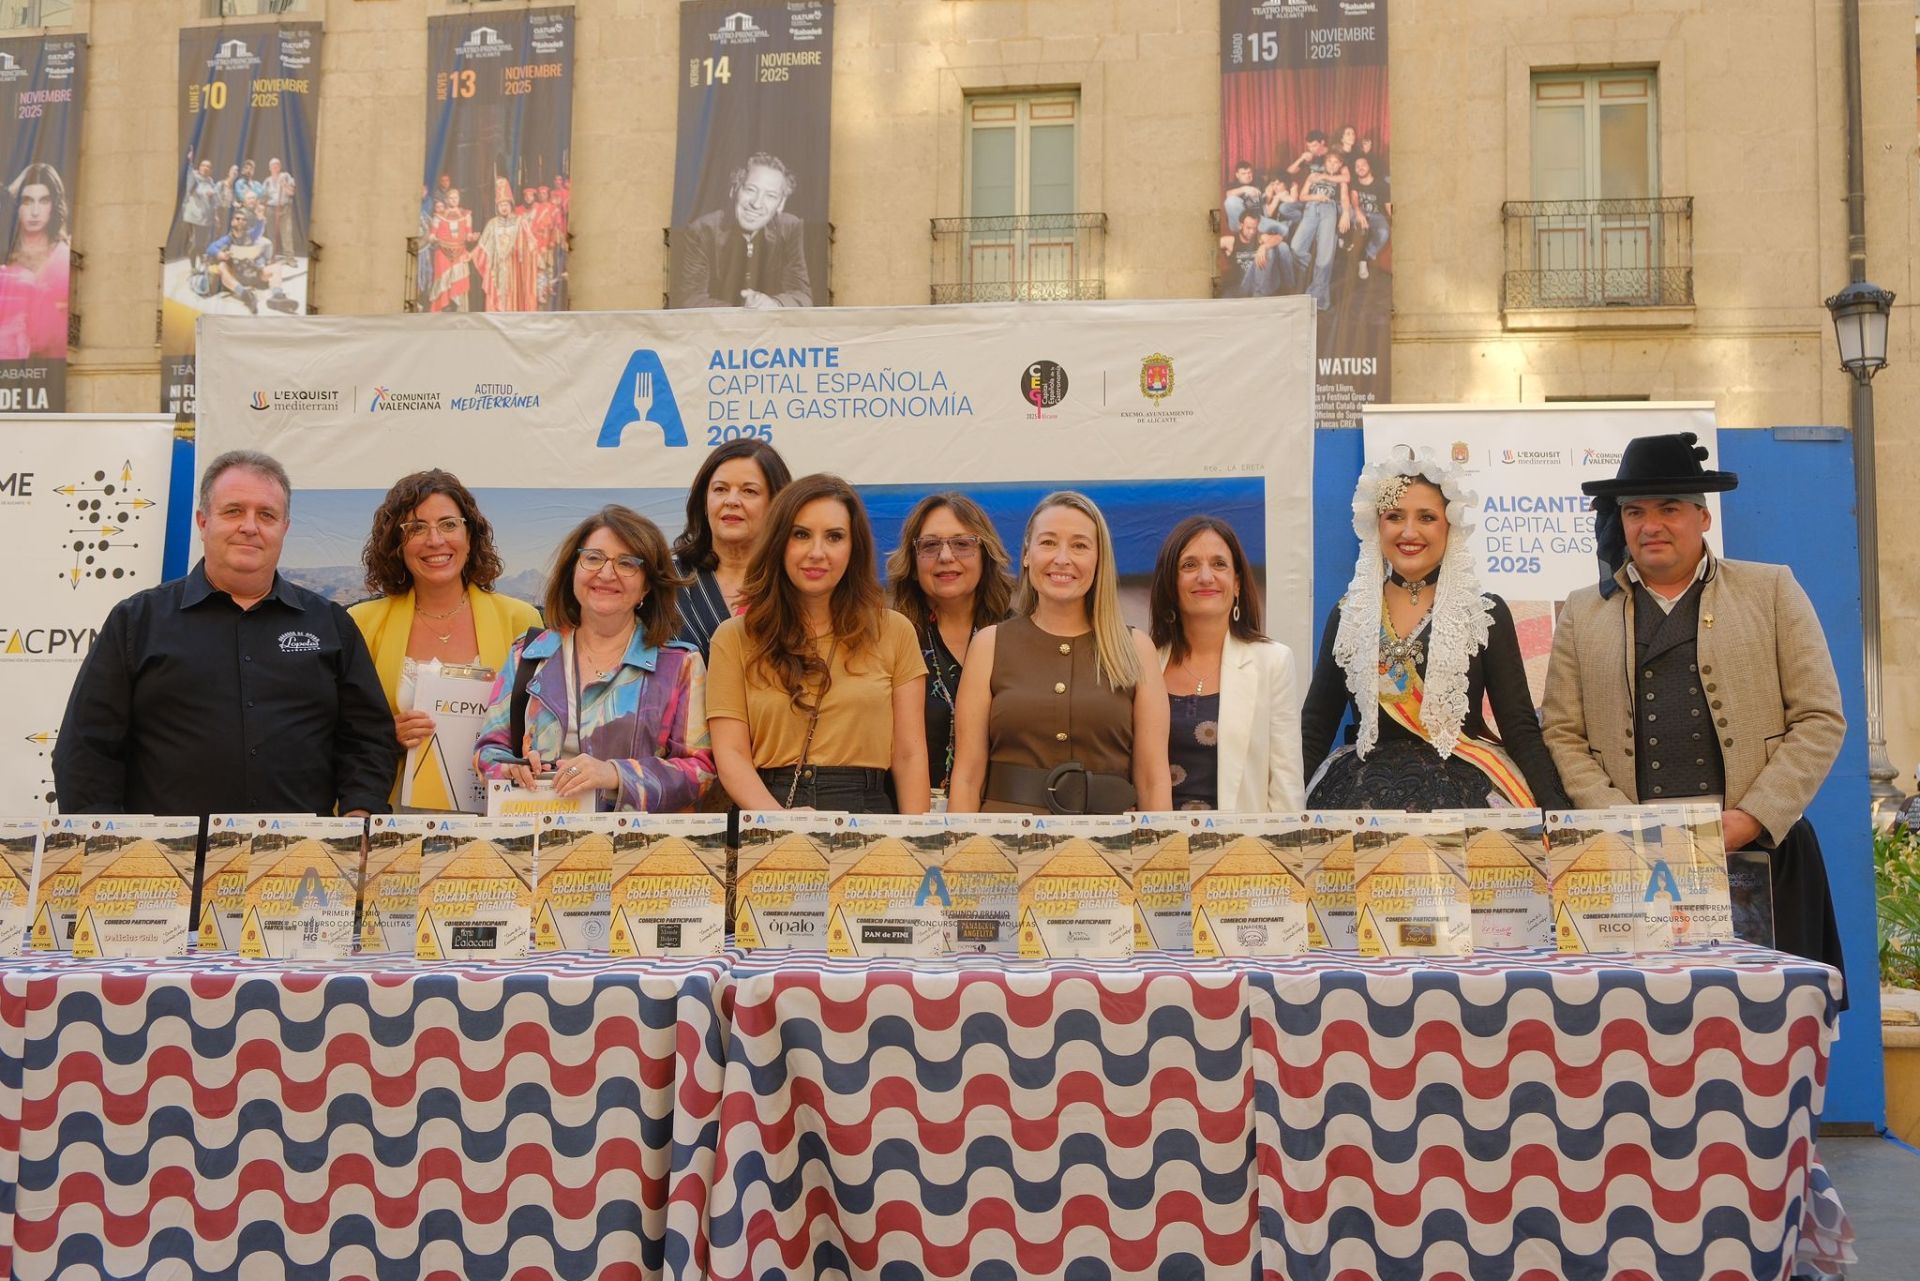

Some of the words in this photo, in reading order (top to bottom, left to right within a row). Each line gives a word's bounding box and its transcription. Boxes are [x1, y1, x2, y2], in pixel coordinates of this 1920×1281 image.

[1252, 6, 1281, 15] TEATRO
[1281, 5, 1318, 14] PRINCIPAL
[708, 31, 735, 40] TEATRO
[735, 30, 770, 38] PRINCIPAL
[1310, 26, 1376, 43] NOVIEMBRE
[1247, 31, 1279, 62] 15
[1310, 43, 1342, 60] 2025
[761, 51, 822, 67] NOVIEMBRE
[505, 64, 563, 80] NOVIEMBRE
[703, 55, 731, 86] 14
[760, 68, 789, 83] 2025
[252, 79, 310, 94] NOVIEMBRE
[450, 70, 476, 98] 13
[505, 80, 532, 95] 2025
[20, 89, 72, 104] NOVIEMBRE
[189, 84, 200, 113] LUNES
[202, 81, 227, 110] 10
[251, 93, 279, 108] 2025
[19, 105, 42, 119] 2025
[708, 347, 839, 370] ALICANTE
[1318, 357, 1377, 376] WATUSI
[708, 374, 808, 395] CAPITAL
[817, 368, 948, 393] ESPAÑOLA
[274, 391, 338, 401] L'EXQUISIT
[391, 393, 441, 401] COMUNITAT
[475, 384, 514, 395] ACTITUD
[27, 387, 49, 409] LA
[451, 393, 540, 411] MEDITERRÁNEA
[274, 400, 338, 412] mediterrani
[380, 401, 442, 411] VALENCIANA
[708, 401, 740, 421] DE
[750, 400, 778, 420] LA
[787, 392, 973, 419] GASTRONOMÍA
[707, 424, 773, 447] 2025
[1484, 496, 1591, 513] ALICANTE
[1484, 516, 1567, 533] CAPITAL
[1487, 537, 1512, 553] DE
[1520, 537, 1544, 553] LA
[1487, 556, 1541, 573] 2025
[97, 878, 181, 893] CONCURSO
[434, 879, 518, 893] CONCURSO
[627, 877, 711, 891] CONCURSO
[1034, 878, 1119, 892] CONCURSO
[1207, 875, 1291, 891] CONCURSO
[1371, 876, 1456, 890] CONCURSO
[1491, 880, 1534, 889] MOLLITAS
[1568, 886, 1593, 895] COCA
[95, 891, 120, 901] COCA
[120, 891, 135, 900] DE
[135, 890, 178, 900] MOLLITAS
[434, 892, 459, 902] COCA
[460, 892, 474, 901] DE
[474, 890, 518, 900] MOLLITAS
[653, 889, 667, 898] DE
[667, 887, 711, 898] MOLLITAS
[845, 891, 870, 899] COCA
[1035, 891, 1060, 900] COCA
[1061, 890, 1075, 899] DE
[1076, 889, 1119, 899] MOLLITAS
[1207, 890, 1232, 899] COCA
[1233, 889, 1247, 898] DE
[1247, 887, 1290, 898] MOLLITAS
[1371, 889, 1397, 898] COCA
[1398, 888, 1412, 897] DE
[1412, 887, 1456, 897] MOLLITAS
[1496, 889, 1534, 898] GIGANTE
[553, 894, 594, 909] 2025
[628, 900, 669, 916] 2025
[671, 898, 711, 908] GIGANTE
[752, 893, 793, 908] 2025
[846, 900, 888, 916] 2025
[1036, 901, 1078, 917] 2025
[1079, 899, 1119, 909] GIGANTE
[1143, 894, 1183, 910] 2025
[1208, 900, 1249, 916] 2025
[1251, 897, 1290, 907] GIGANTE
[1373, 899, 1414, 916] 2025
[1416, 897, 1456, 907] GIGANTE
[1570, 895, 1613, 912] 2025
[96, 901, 137, 917] 2025
[137, 900, 176, 910] GIGANTE
[434, 902, 476, 918] 2025
[476, 901, 516, 910] GIGANTE
[1599, 923, 1631, 932] RICO
[303, 934, 318, 942] HG
